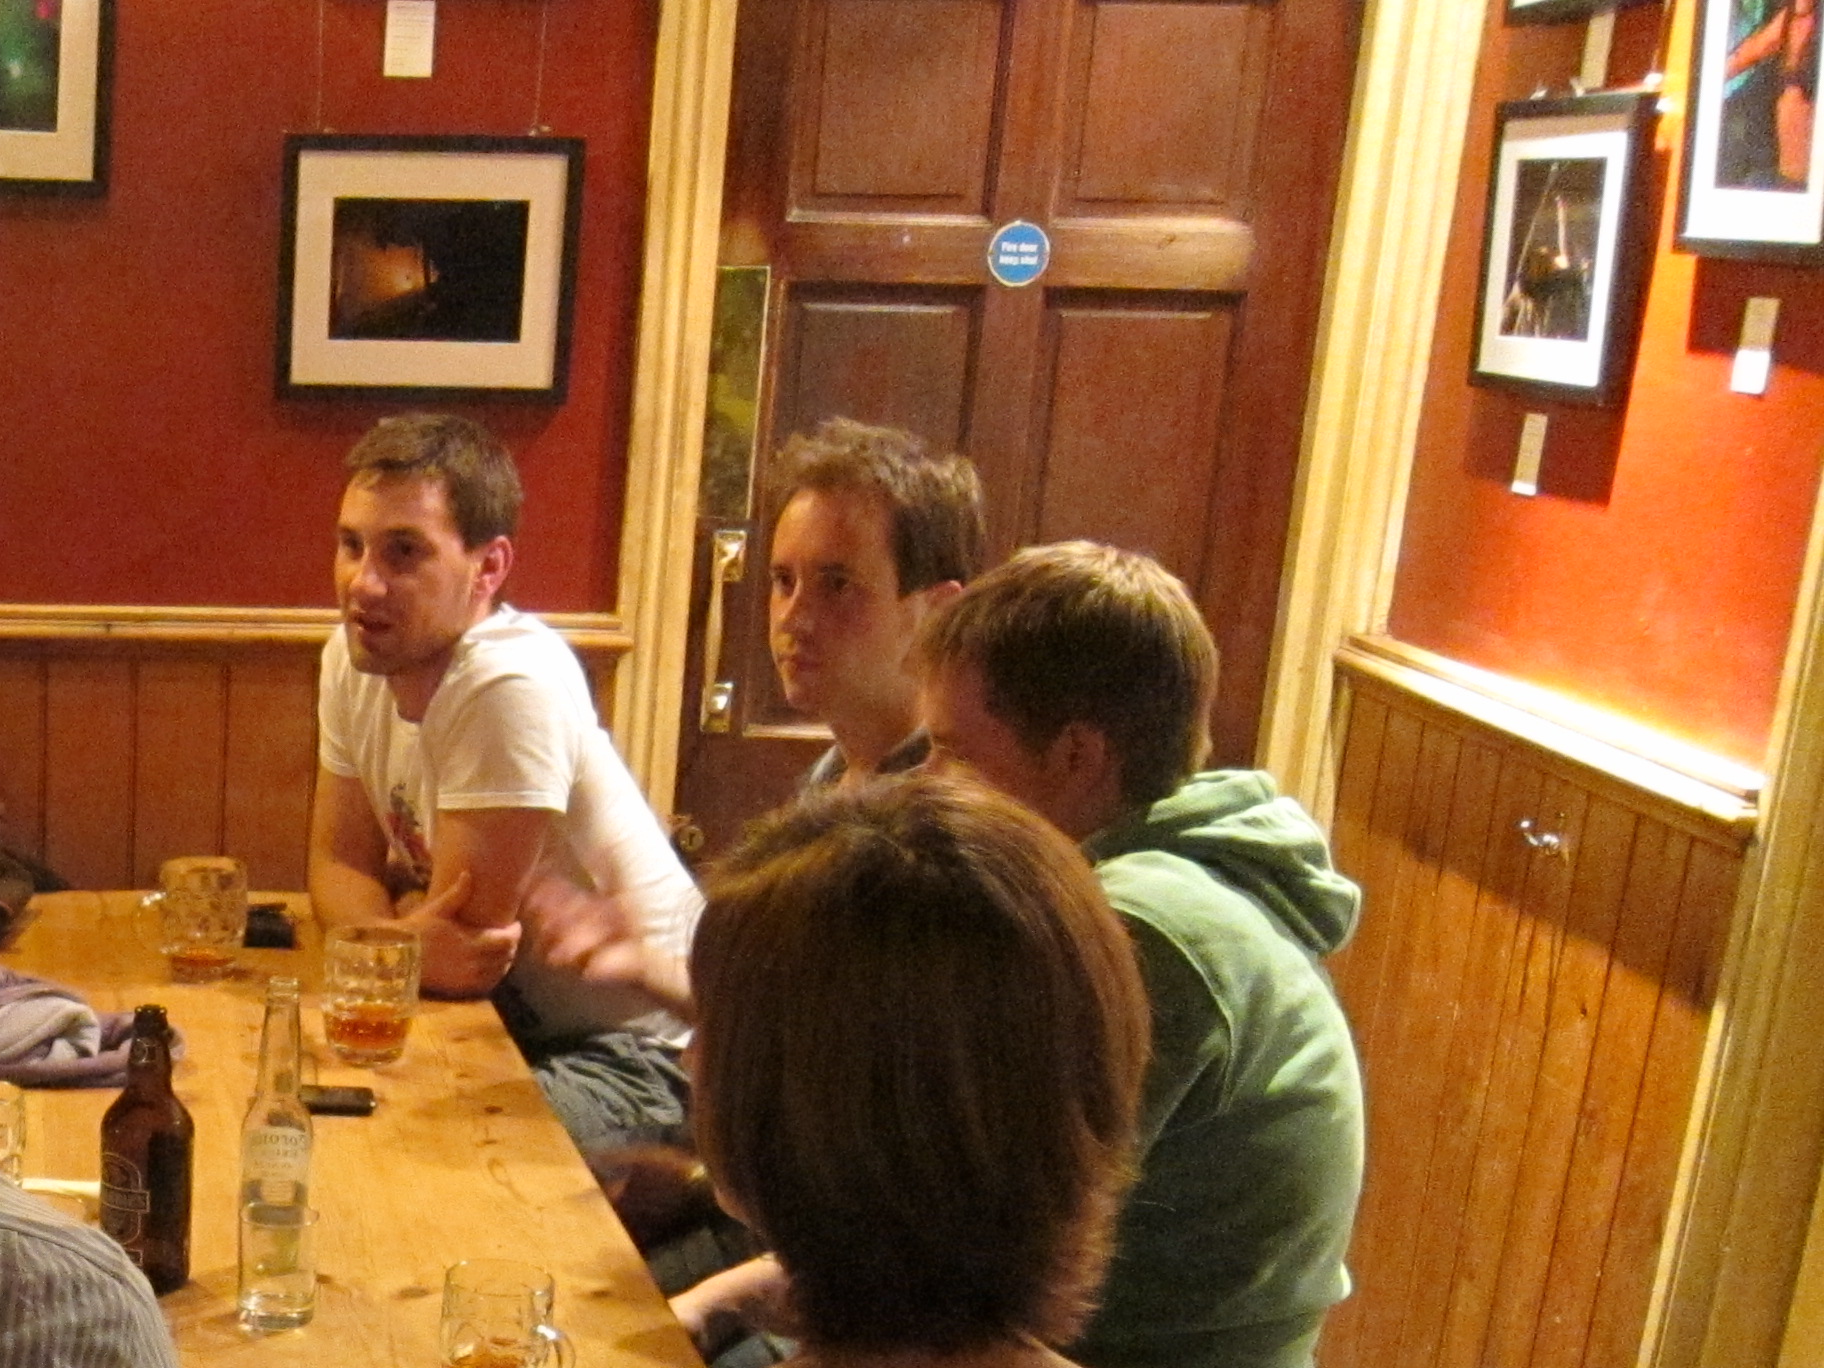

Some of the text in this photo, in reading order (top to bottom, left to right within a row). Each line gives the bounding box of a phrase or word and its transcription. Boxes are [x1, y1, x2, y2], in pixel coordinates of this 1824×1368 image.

[1001, 241, 1039, 252] Fire door
[999, 254, 1039, 266] keep shut
